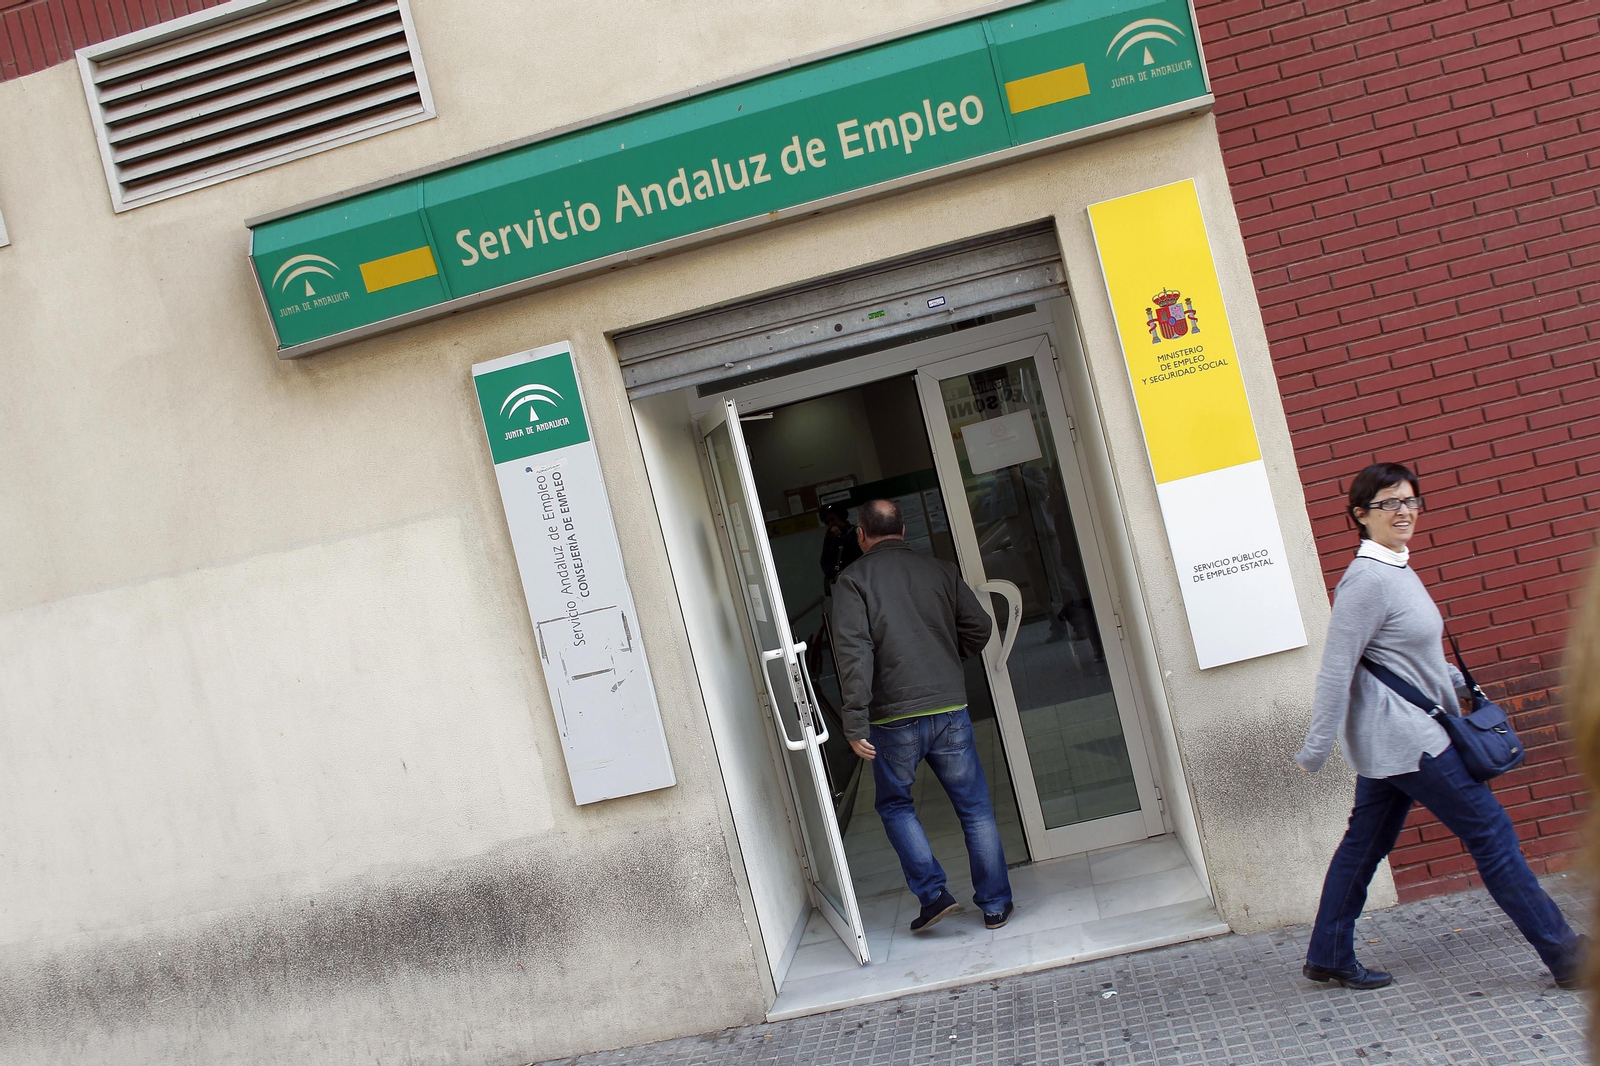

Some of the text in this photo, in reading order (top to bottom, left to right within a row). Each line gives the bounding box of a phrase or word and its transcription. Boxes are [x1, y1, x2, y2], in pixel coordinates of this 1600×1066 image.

[1111, 74, 1136, 89] JUNTA
[1138, 71, 1148, 81] DE
[455, 94, 984, 267] Servicio Andaluz de Empleo
[279, 304, 301, 317] JUNTA
[302, 302, 312, 311] DE
[1157, 345, 1204, 362] MINISTERIO
[1160, 354, 1206, 371] DE EMPLEO
[1141, 359, 1229, 386] Y SEGURIDAD SOCIAL
[504, 429, 525, 441] JUNTA
[526, 426, 535, 434] DE
[536, 475, 556, 521] Empleo
[548, 526, 560, 541] de
[552, 471, 590, 598] CONSEJERÍA DE EMPLEO
[553, 545, 573, 595] Andaluz
[1193, 558, 1230, 573] SERVICIO
[1193, 558, 1274, 583] DE EMPLEO ESTATAL
[566, 600, 586, 647] Servicio
